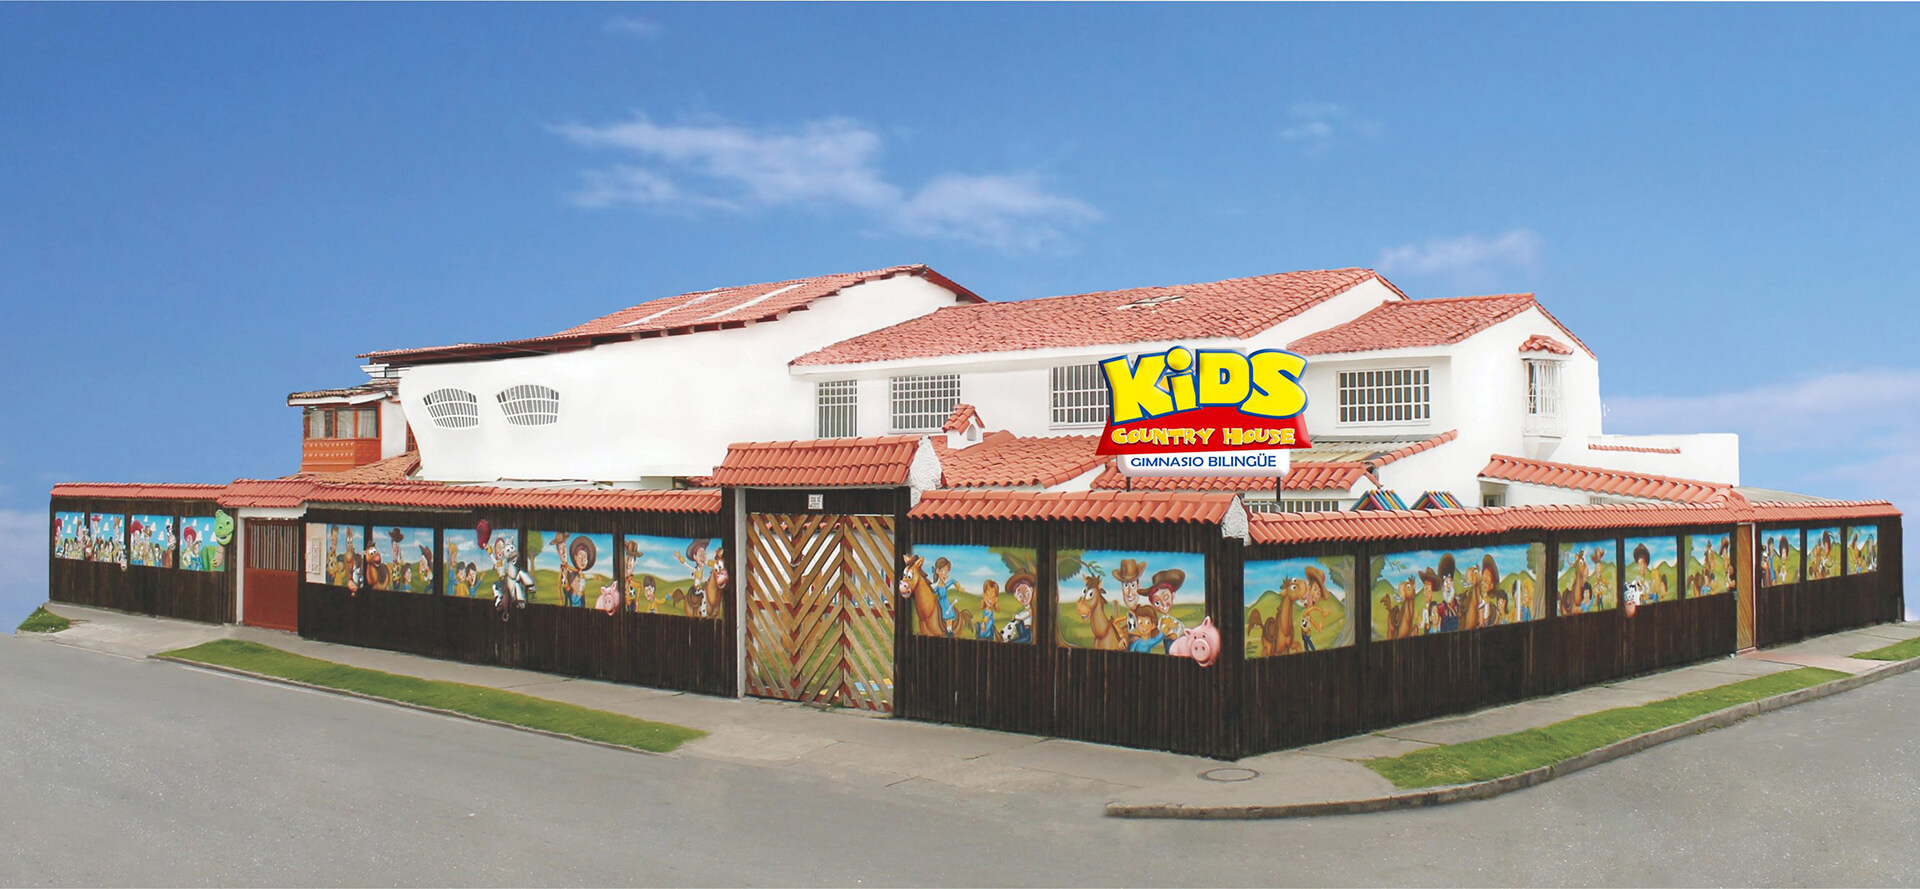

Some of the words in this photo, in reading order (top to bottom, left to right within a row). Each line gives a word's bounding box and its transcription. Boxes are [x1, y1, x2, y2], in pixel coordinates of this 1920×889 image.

[1111, 428, 1214, 445] COUNTRY
[1223, 428, 1296, 445] HOUSE
[1131, 457, 1204, 467] GIMNASIO
[1208, 454, 1277, 467] BILINGÜE
